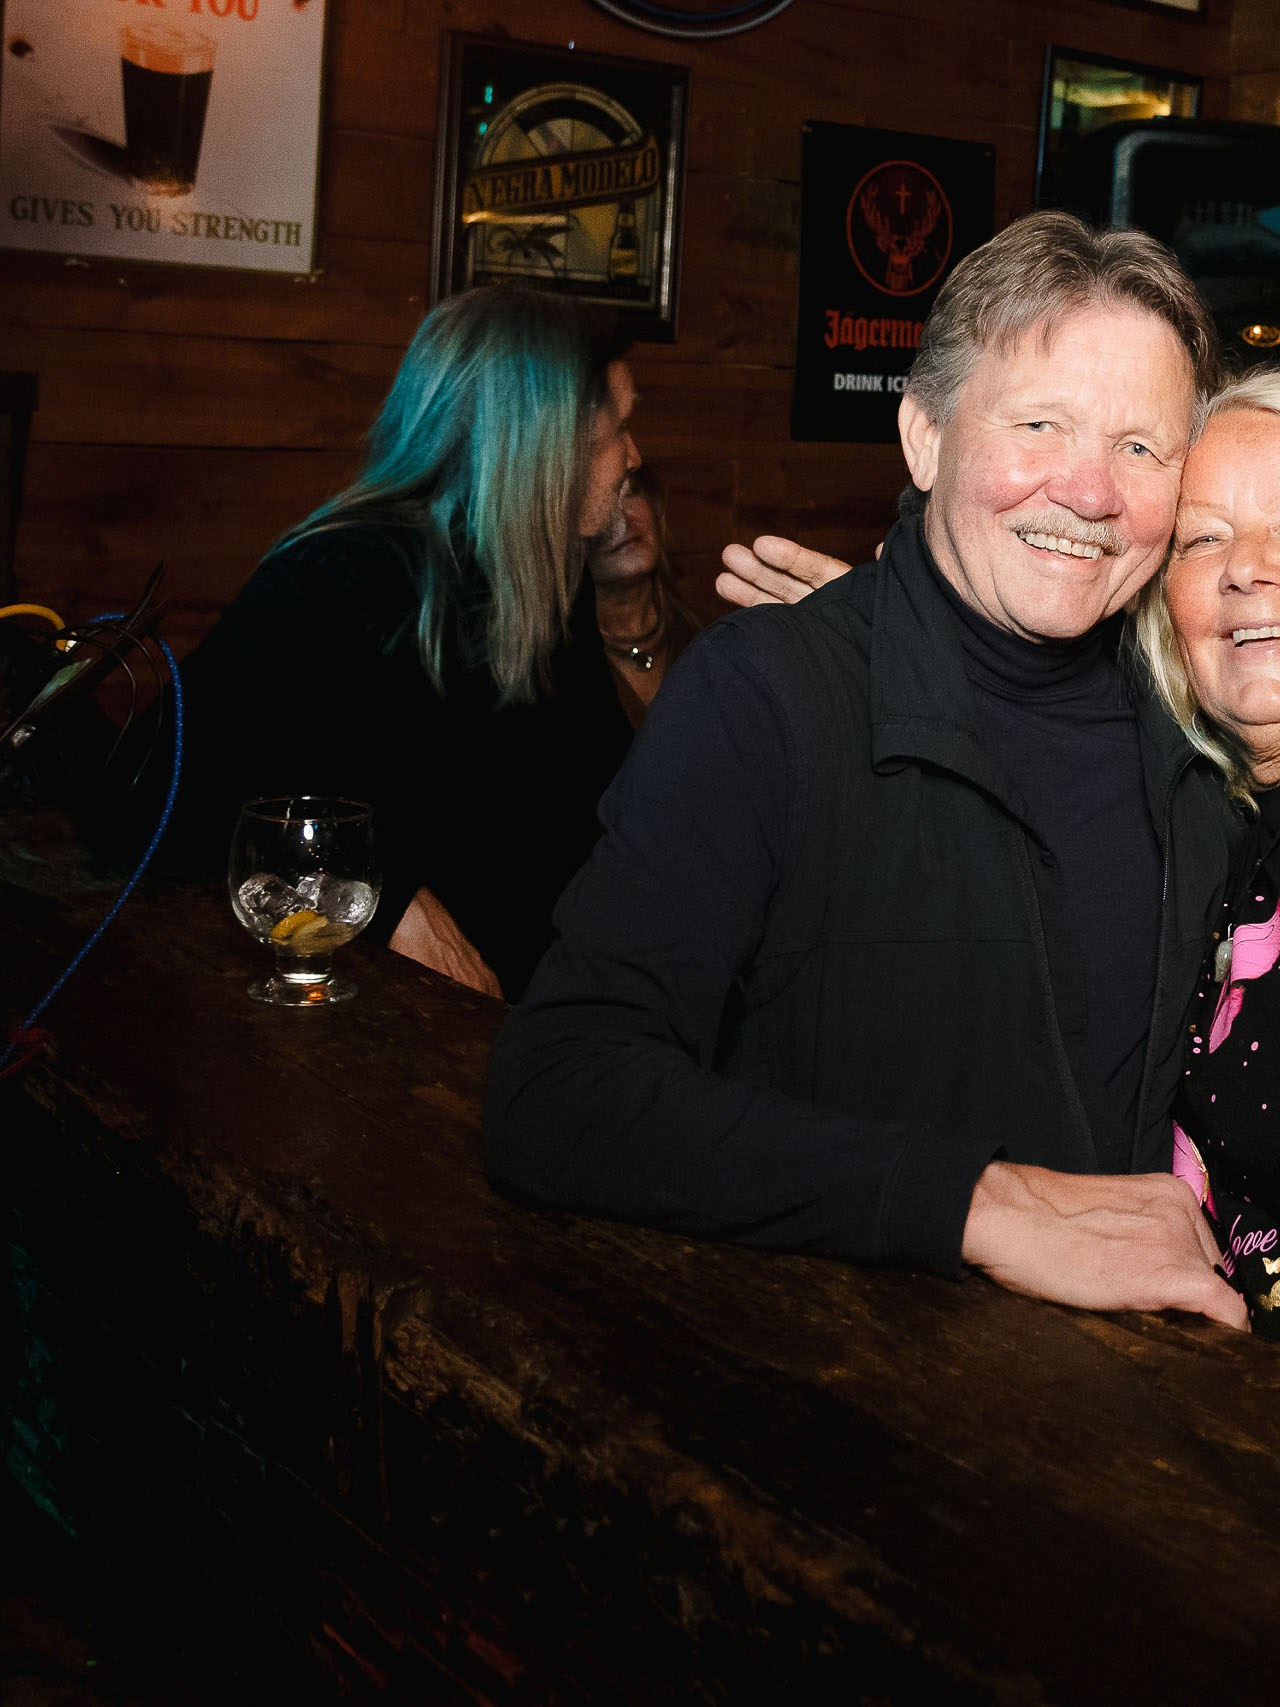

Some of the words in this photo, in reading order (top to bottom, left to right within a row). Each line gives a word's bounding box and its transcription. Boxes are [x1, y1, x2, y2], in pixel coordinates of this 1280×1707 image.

[470, 166, 554, 208] NEGRA
[560, 150, 656, 196] MODELO
[10, 195, 94, 227] GIVES
[109, 203, 161, 233] YOU
[170, 212, 302, 247] STRENGTH
[833, 373, 884, 392] DRINK
